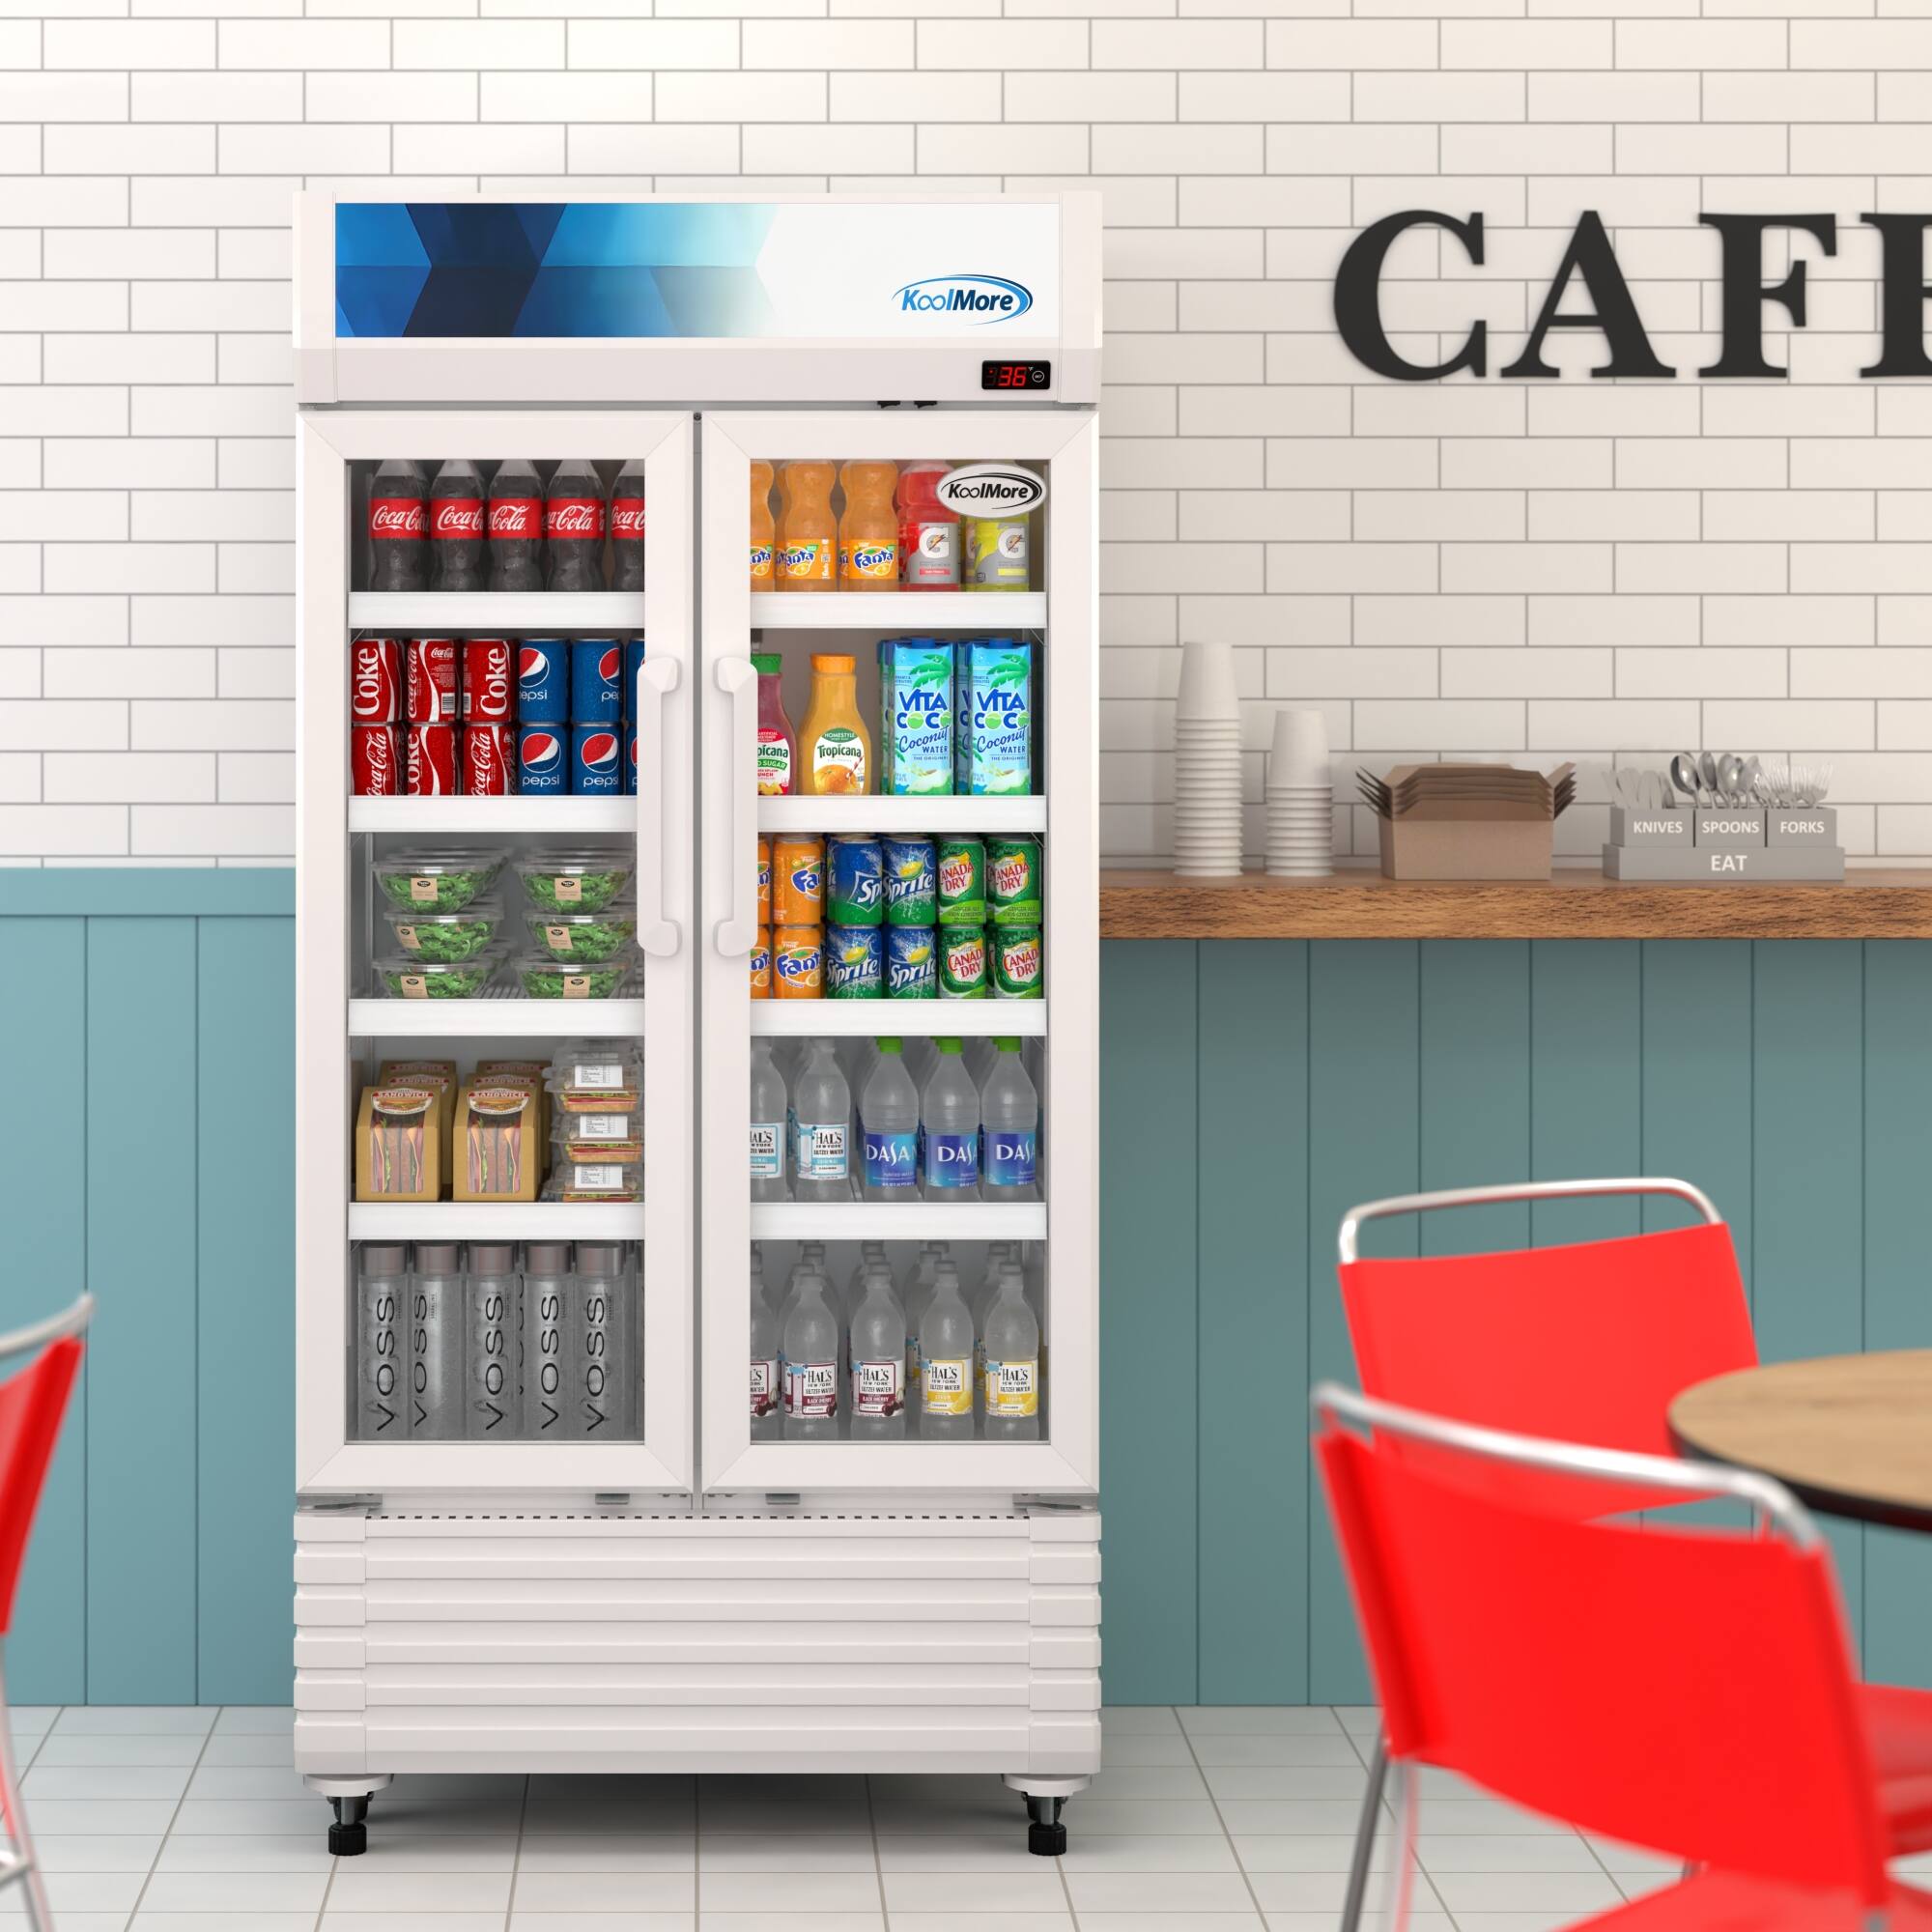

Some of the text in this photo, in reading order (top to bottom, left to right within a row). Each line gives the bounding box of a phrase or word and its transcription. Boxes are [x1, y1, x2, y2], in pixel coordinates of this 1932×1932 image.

[901, 288, 1013, 311] KoolMore
[998, 366, 1027, 386] 36
[948, 482, 1029, 499] KoolMore
[855, 550, 895, 569] Fanta
[354, 648, 380, 716] Coke
[481, 648, 507, 716] Coke
[520, 690, 548, 703] epsi
[898, 689, 948, 711] VITA
[976, 689, 1026, 711] VITA
[899, 724, 950, 753] Coconut
[978, 724, 1028, 753] Coconut
[817, 744, 862, 758] Tropicana
[923, 745, 948, 753] WATER
[1001, 745, 1026, 753] WATER
[523, 775, 559, 788] pepsi
[1634, 821, 1683, 834] KNIVES
[1702, 821, 1759, 834] SPOONS
[1780, 821, 1825, 834] FORKS
[1711, 855, 1747, 871] EAT
[945, 876, 967, 892] DRY
[1001, 876, 1023, 892] DRY
[776, 952, 819, 978] Fant
[949, 950, 983, 972] CANAD
[1003, 949, 1039, 972] CANAD
[960, 962, 980, 978] DRY
[1016, 962, 1037, 978] DRY
[815, 1132, 842, 1145] HAL'S
[867, 1142, 916, 1167] DASA
[377, 1296, 394, 1431] VOSS
[413, 1295, 427, 1428] VOSS
[486, 1295, 503, 1430] VOSS
[541, 1295, 558, 1430] VOSS
[586, 1297, 604, 1432] VOSS
[808, 1370, 832, 1382] HAL'S
[863, 1368, 890, 1381] HAL'S
[931, 1366, 957, 1379] HAL'S
[1002, 1368, 1029, 1381] HAL'S
